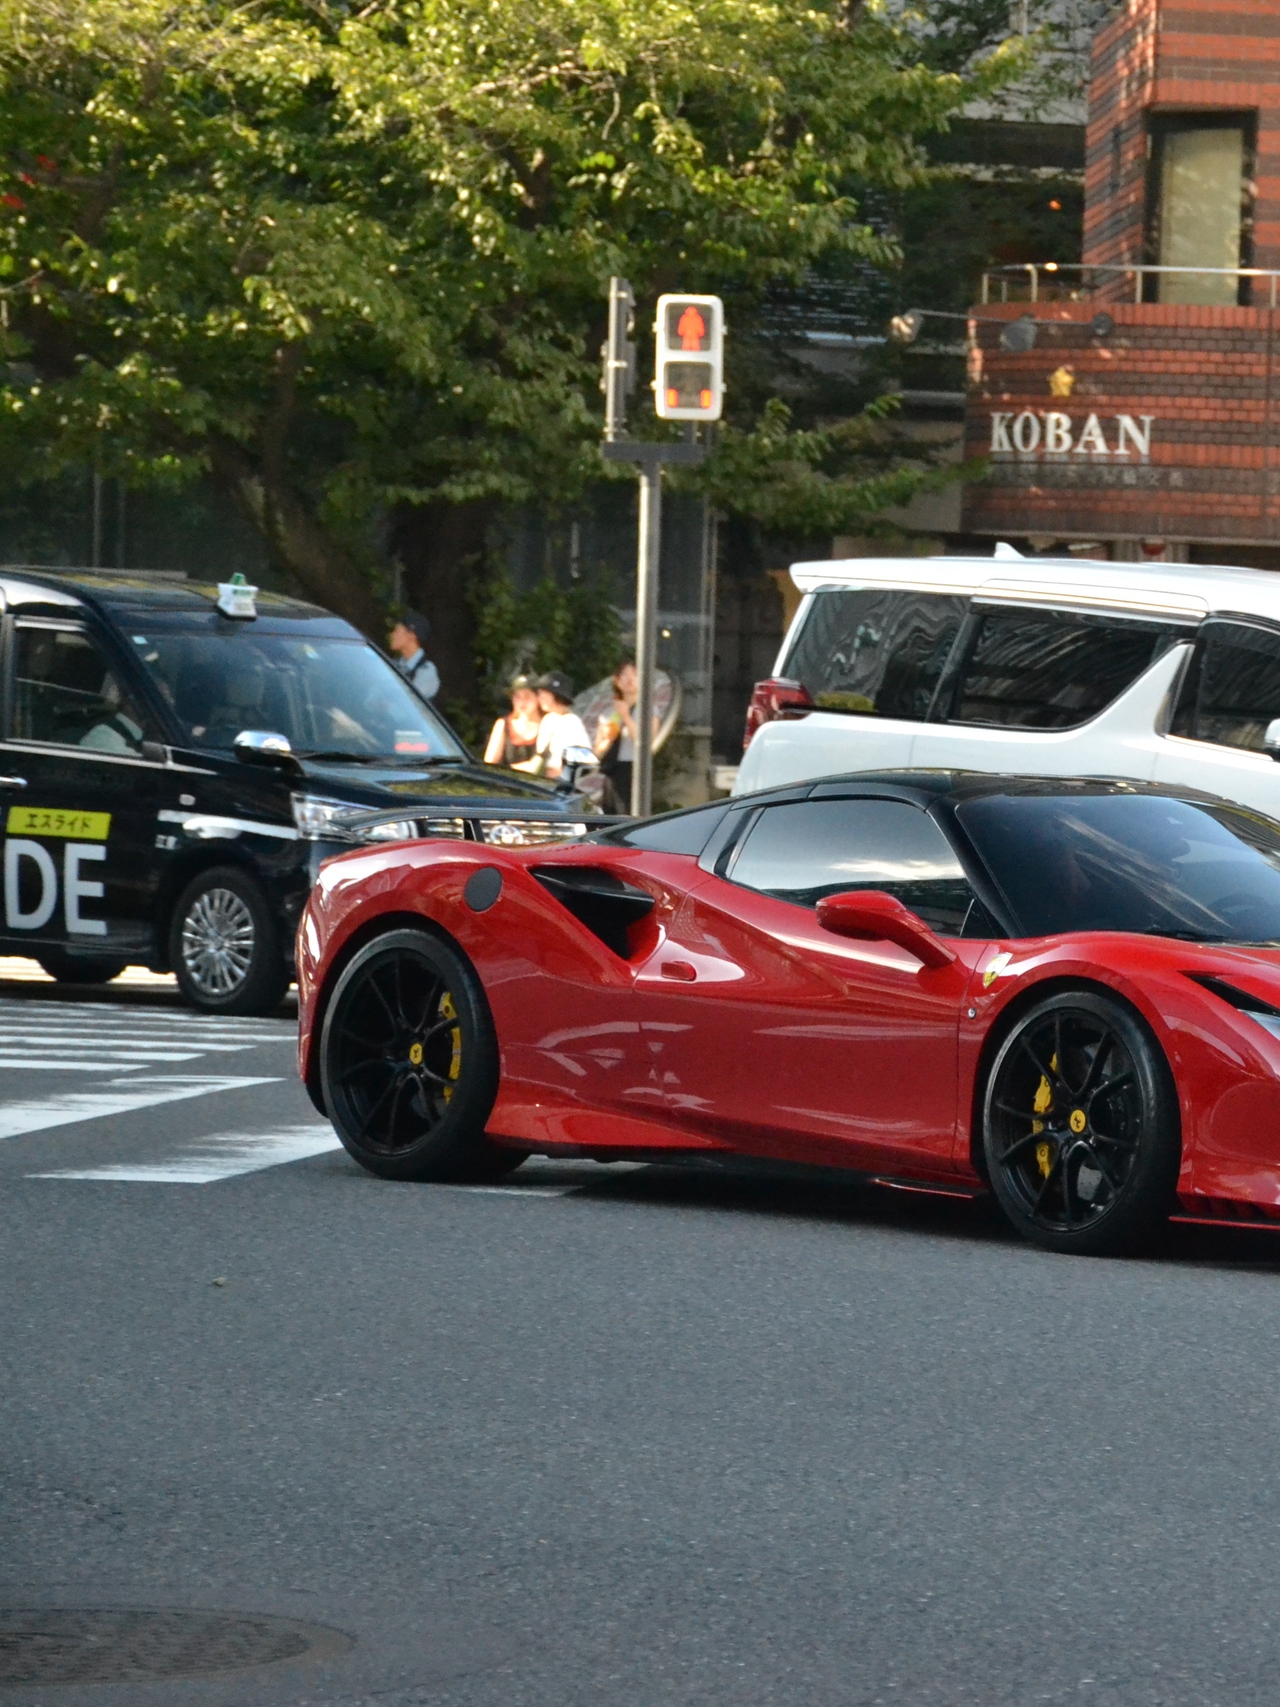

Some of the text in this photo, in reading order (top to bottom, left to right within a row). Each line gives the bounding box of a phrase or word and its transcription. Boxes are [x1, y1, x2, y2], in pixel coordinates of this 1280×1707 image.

[989, 411, 1156, 456] KOBAN
[24, 813, 92, 834] エスライド
[4, 838, 108, 936] DE
